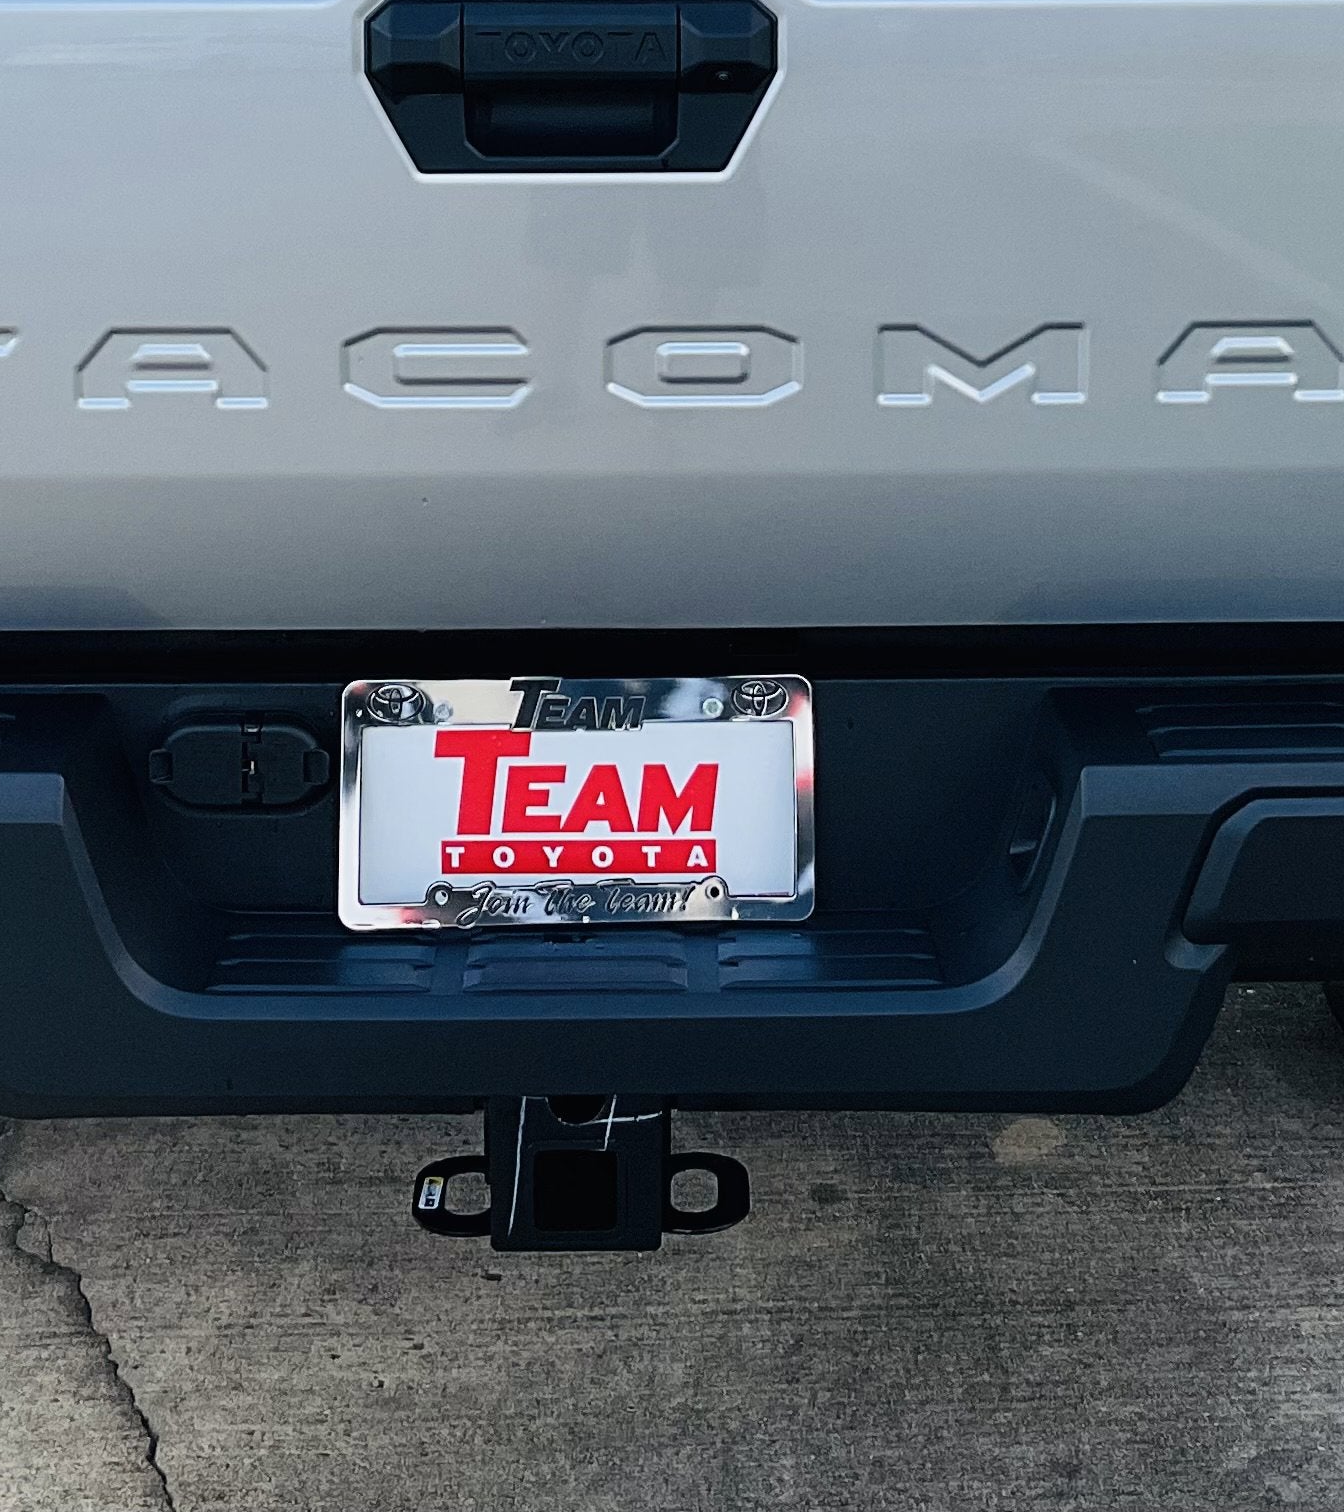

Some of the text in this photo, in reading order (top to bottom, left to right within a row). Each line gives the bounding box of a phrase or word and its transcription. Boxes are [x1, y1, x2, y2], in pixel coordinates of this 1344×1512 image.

[473, 30, 668, 65] TOYOTA
[509, 677, 646, 732] TEAM
[434, 729, 719, 836] TEAM
[445, 845, 709, 868] TOYOTA
